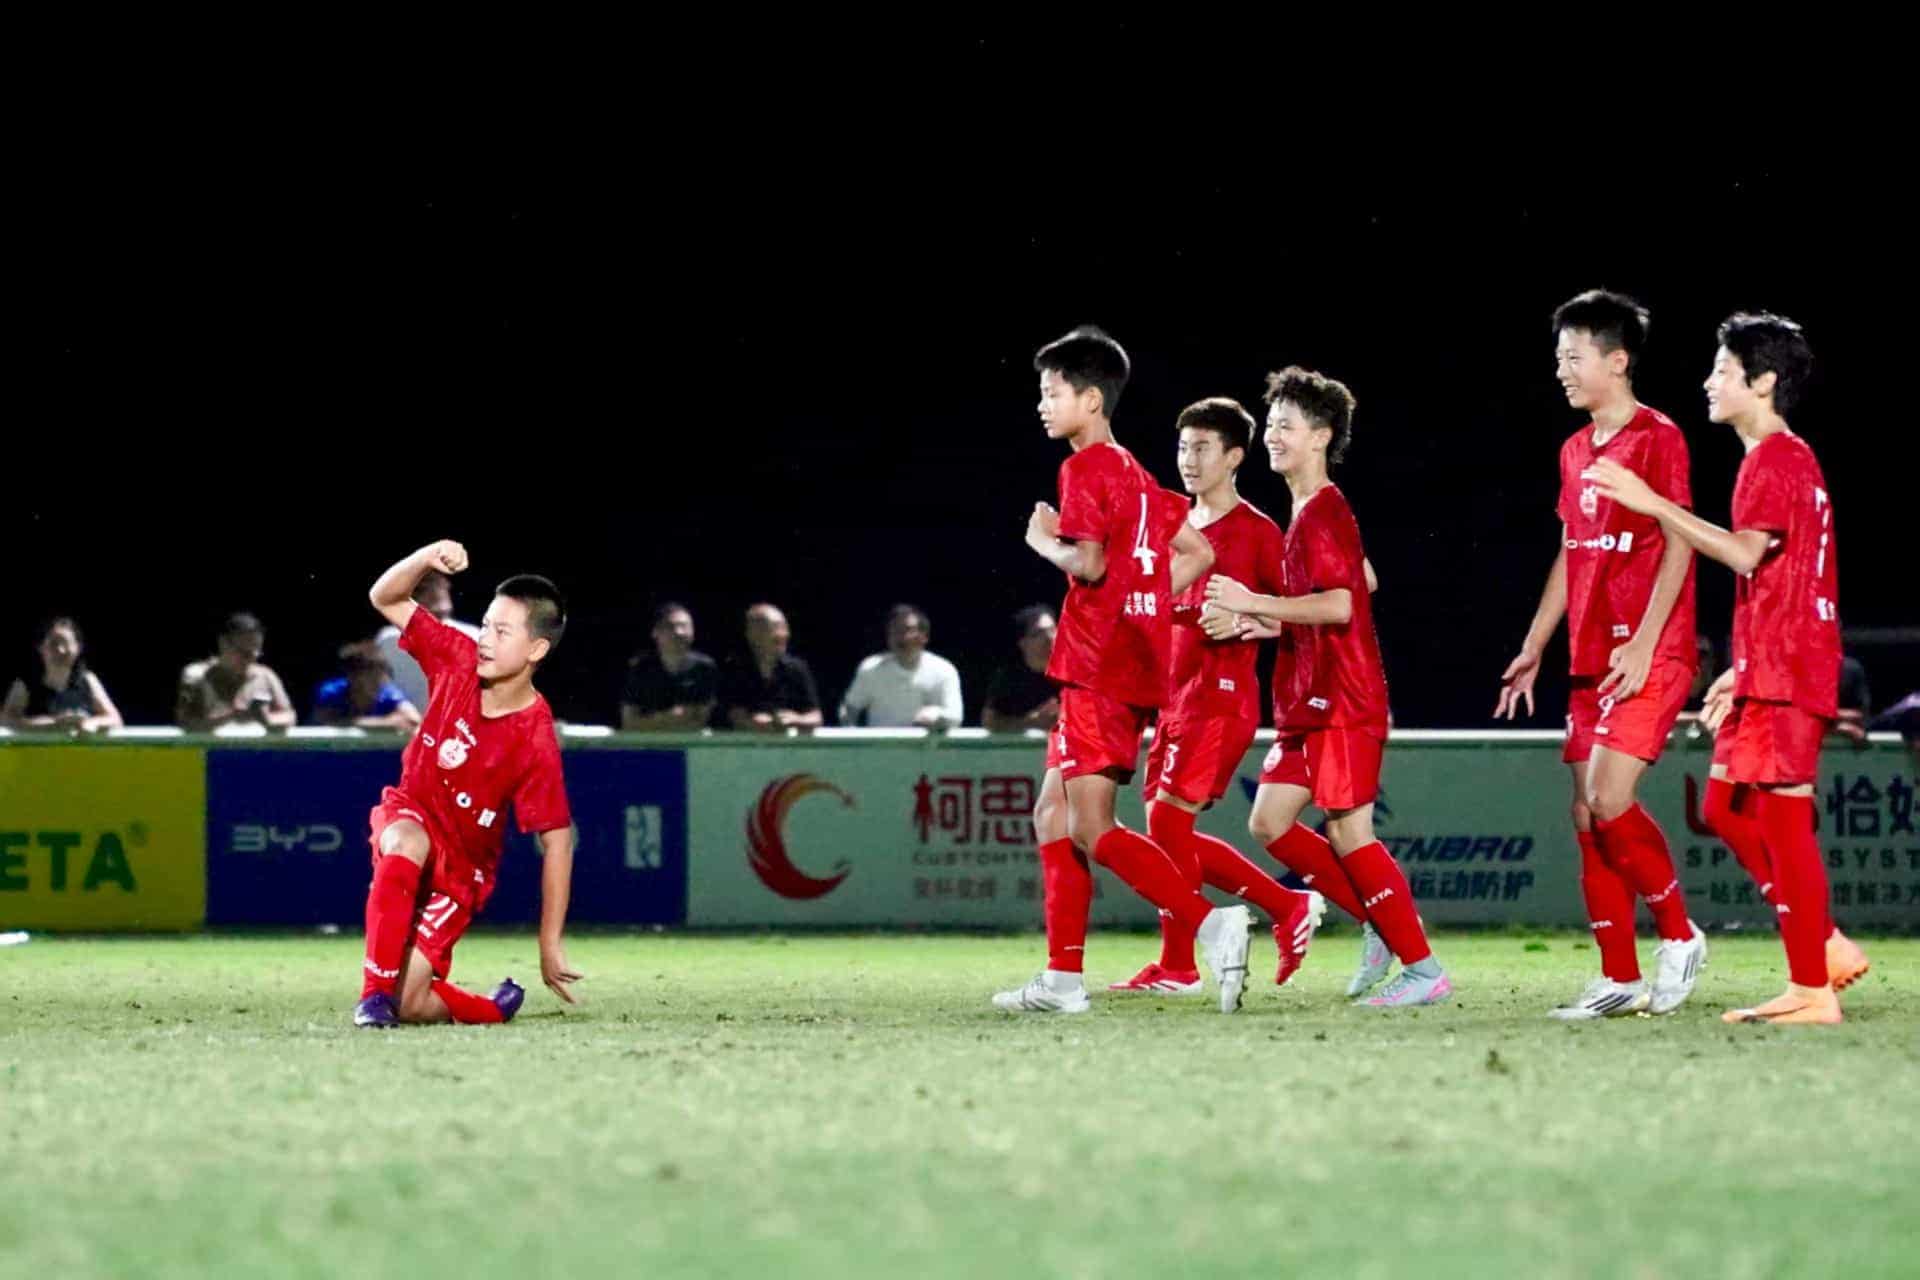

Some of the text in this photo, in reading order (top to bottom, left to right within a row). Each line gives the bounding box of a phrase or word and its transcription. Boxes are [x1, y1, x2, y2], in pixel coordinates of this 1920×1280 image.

[1132, 492, 1158, 576] 4
[232, 824, 343, 852] BYD
[421, 892, 458, 930] 21
